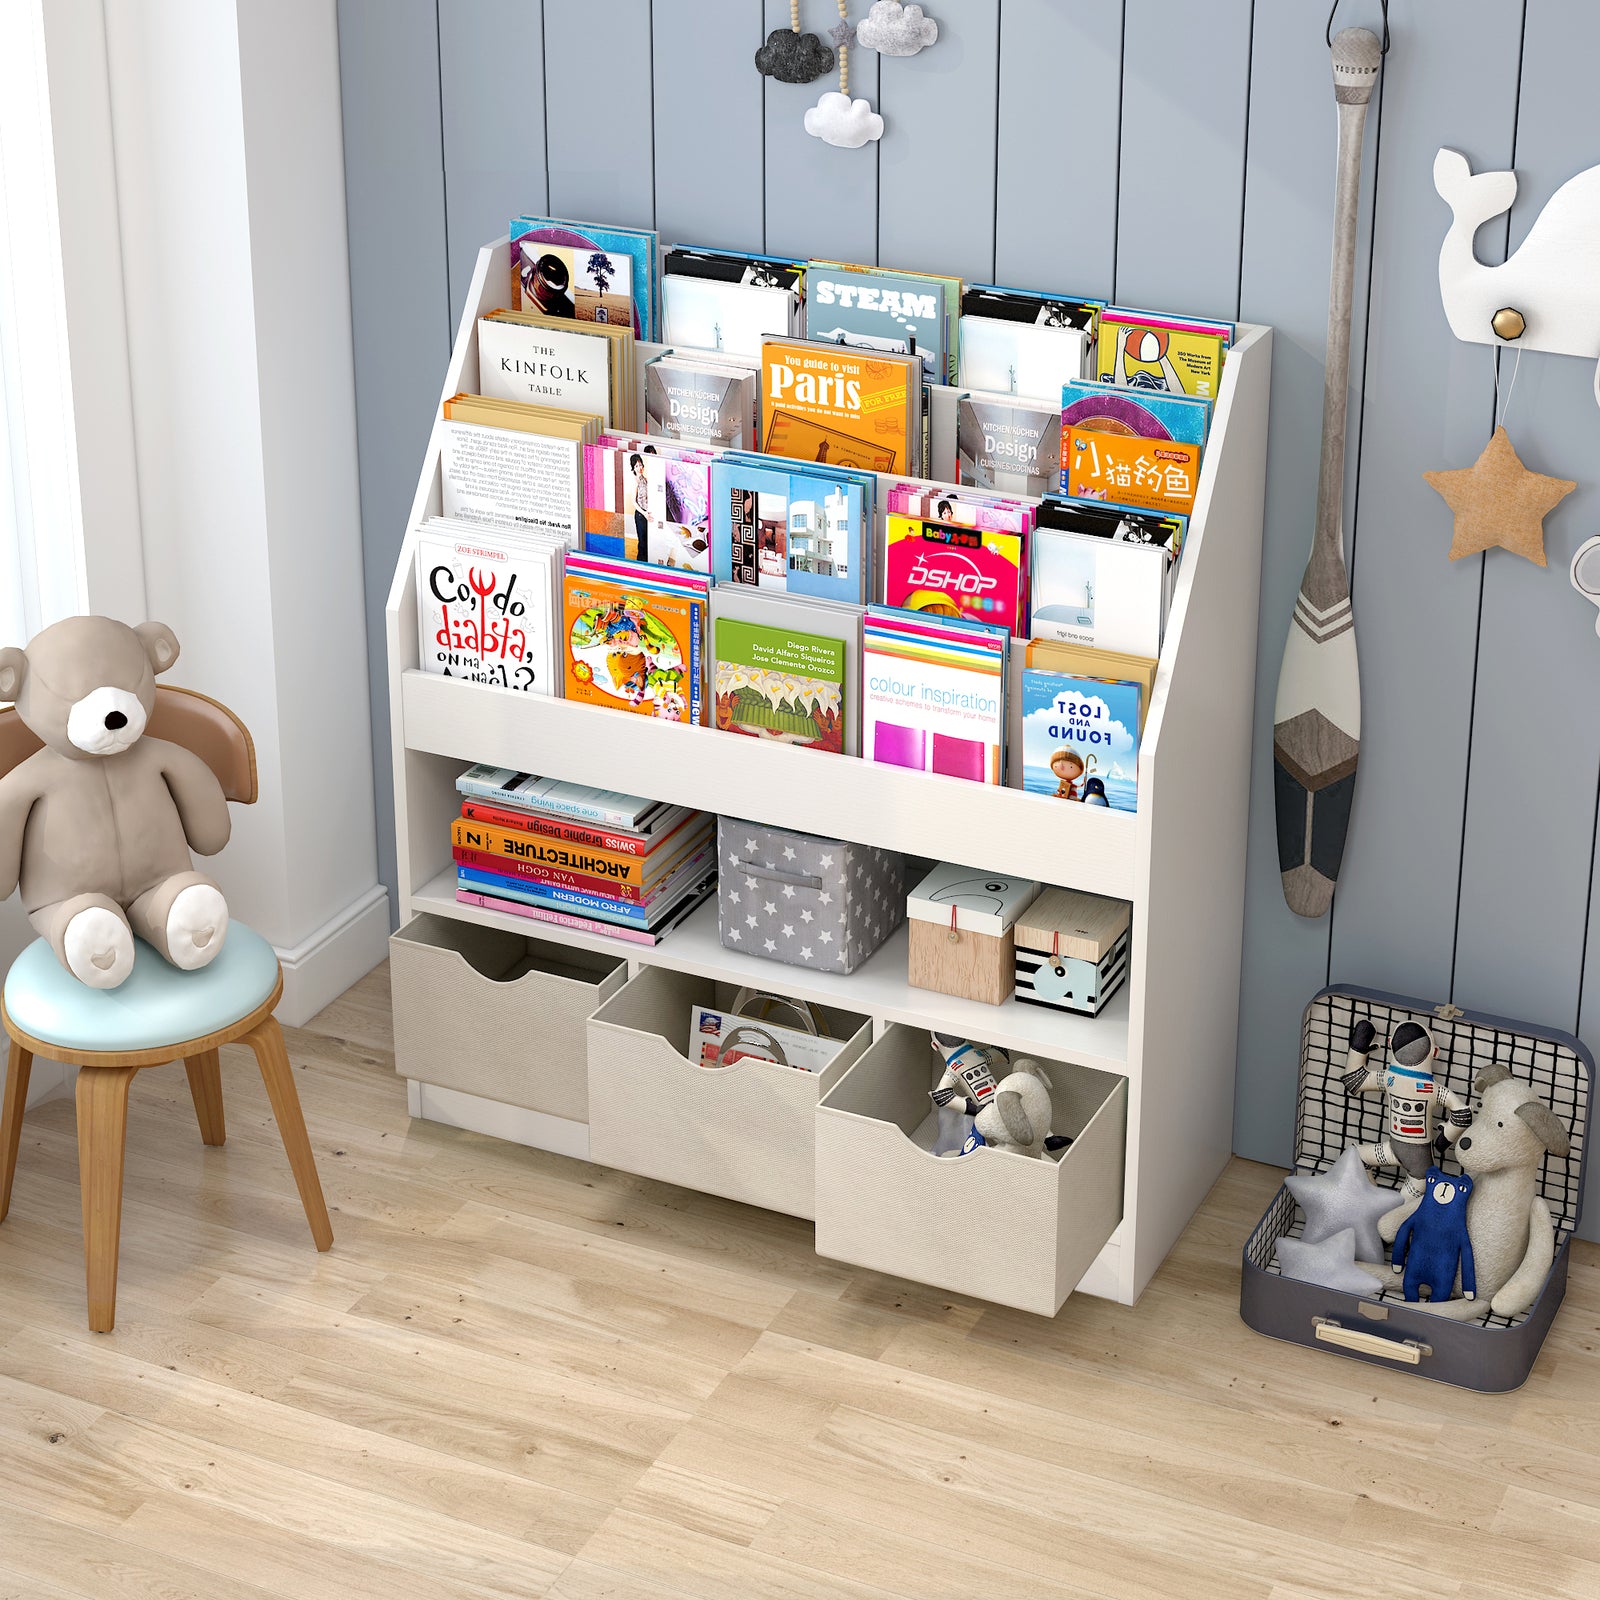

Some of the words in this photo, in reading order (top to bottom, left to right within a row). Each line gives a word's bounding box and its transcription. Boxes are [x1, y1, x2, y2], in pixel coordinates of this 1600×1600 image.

[816, 280, 936, 319] STEAM
[533, 345, 556, 357] THE
[501, 357, 590, 384] KINFOLK
[784, 354, 800, 366] You
[803, 358, 829, 370] guide
[830, 363, 839, 372] to
[842, 364, 860, 375] visit
[528, 383, 562, 397] TABLE
[770, 363, 860, 410] Paris
[863, 397, 882, 408] FOR
[884, 390, 906, 402] FREE
[670, 398, 718, 426] Design
[984, 435, 1036, 462] Design
[1075, 441, 1192, 498] 小猫钓鱼
[926, 528, 952, 544] Baby
[457, 546, 472, 554] ZOE
[472, 548, 506, 560] STRIMPEL
[907, 566, 998, 594] DSHOP
[430, 566, 476, 611] Co,
[493, 574, 525, 616] do
[752, 644, 774, 654] David
[776, 648, 799, 659] Alfaro
[800, 653, 835, 666] Siqueiros
[787, 641, 810, 652] Diego
[812, 646, 835, 656] Rivera
[752, 654, 768, 662] Jose
[770, 657, 806, 670] Clemente
[808, 664, 835, 675] Orozco
[870, 676, 916, 697] colour
[921, 683, 996, 713] inspiration
[690, 700, 700, 726] new
[870, 693, 894, 704] creative
[896, 697, 923, 710] schemes
[924, 702, 931, 711] to
[932, 704, 962, 717] transform
[962, 711, 976, 720] your
[978, 714, 996, 724] home
[530, 796, 554, 810] living
[556, 804, 580, 815] space
[582, 808, 598, 817] one
[527, 820, 561, 838] Design
[564, 829, 602, 848] Graphic
[606, 838, 636, 854] Swiss
[504, 838, 630, 879] ARCHITECTURE
[518, 864, 550, 878] GOGH
[554, 871, 575, 884] VAN
[552, 890, 600, 908] MODERN
[600, 902, 630, 914] AFRO
[532, 910, 558, 924] Fellini
[559, 916, 592, 932] Federico
